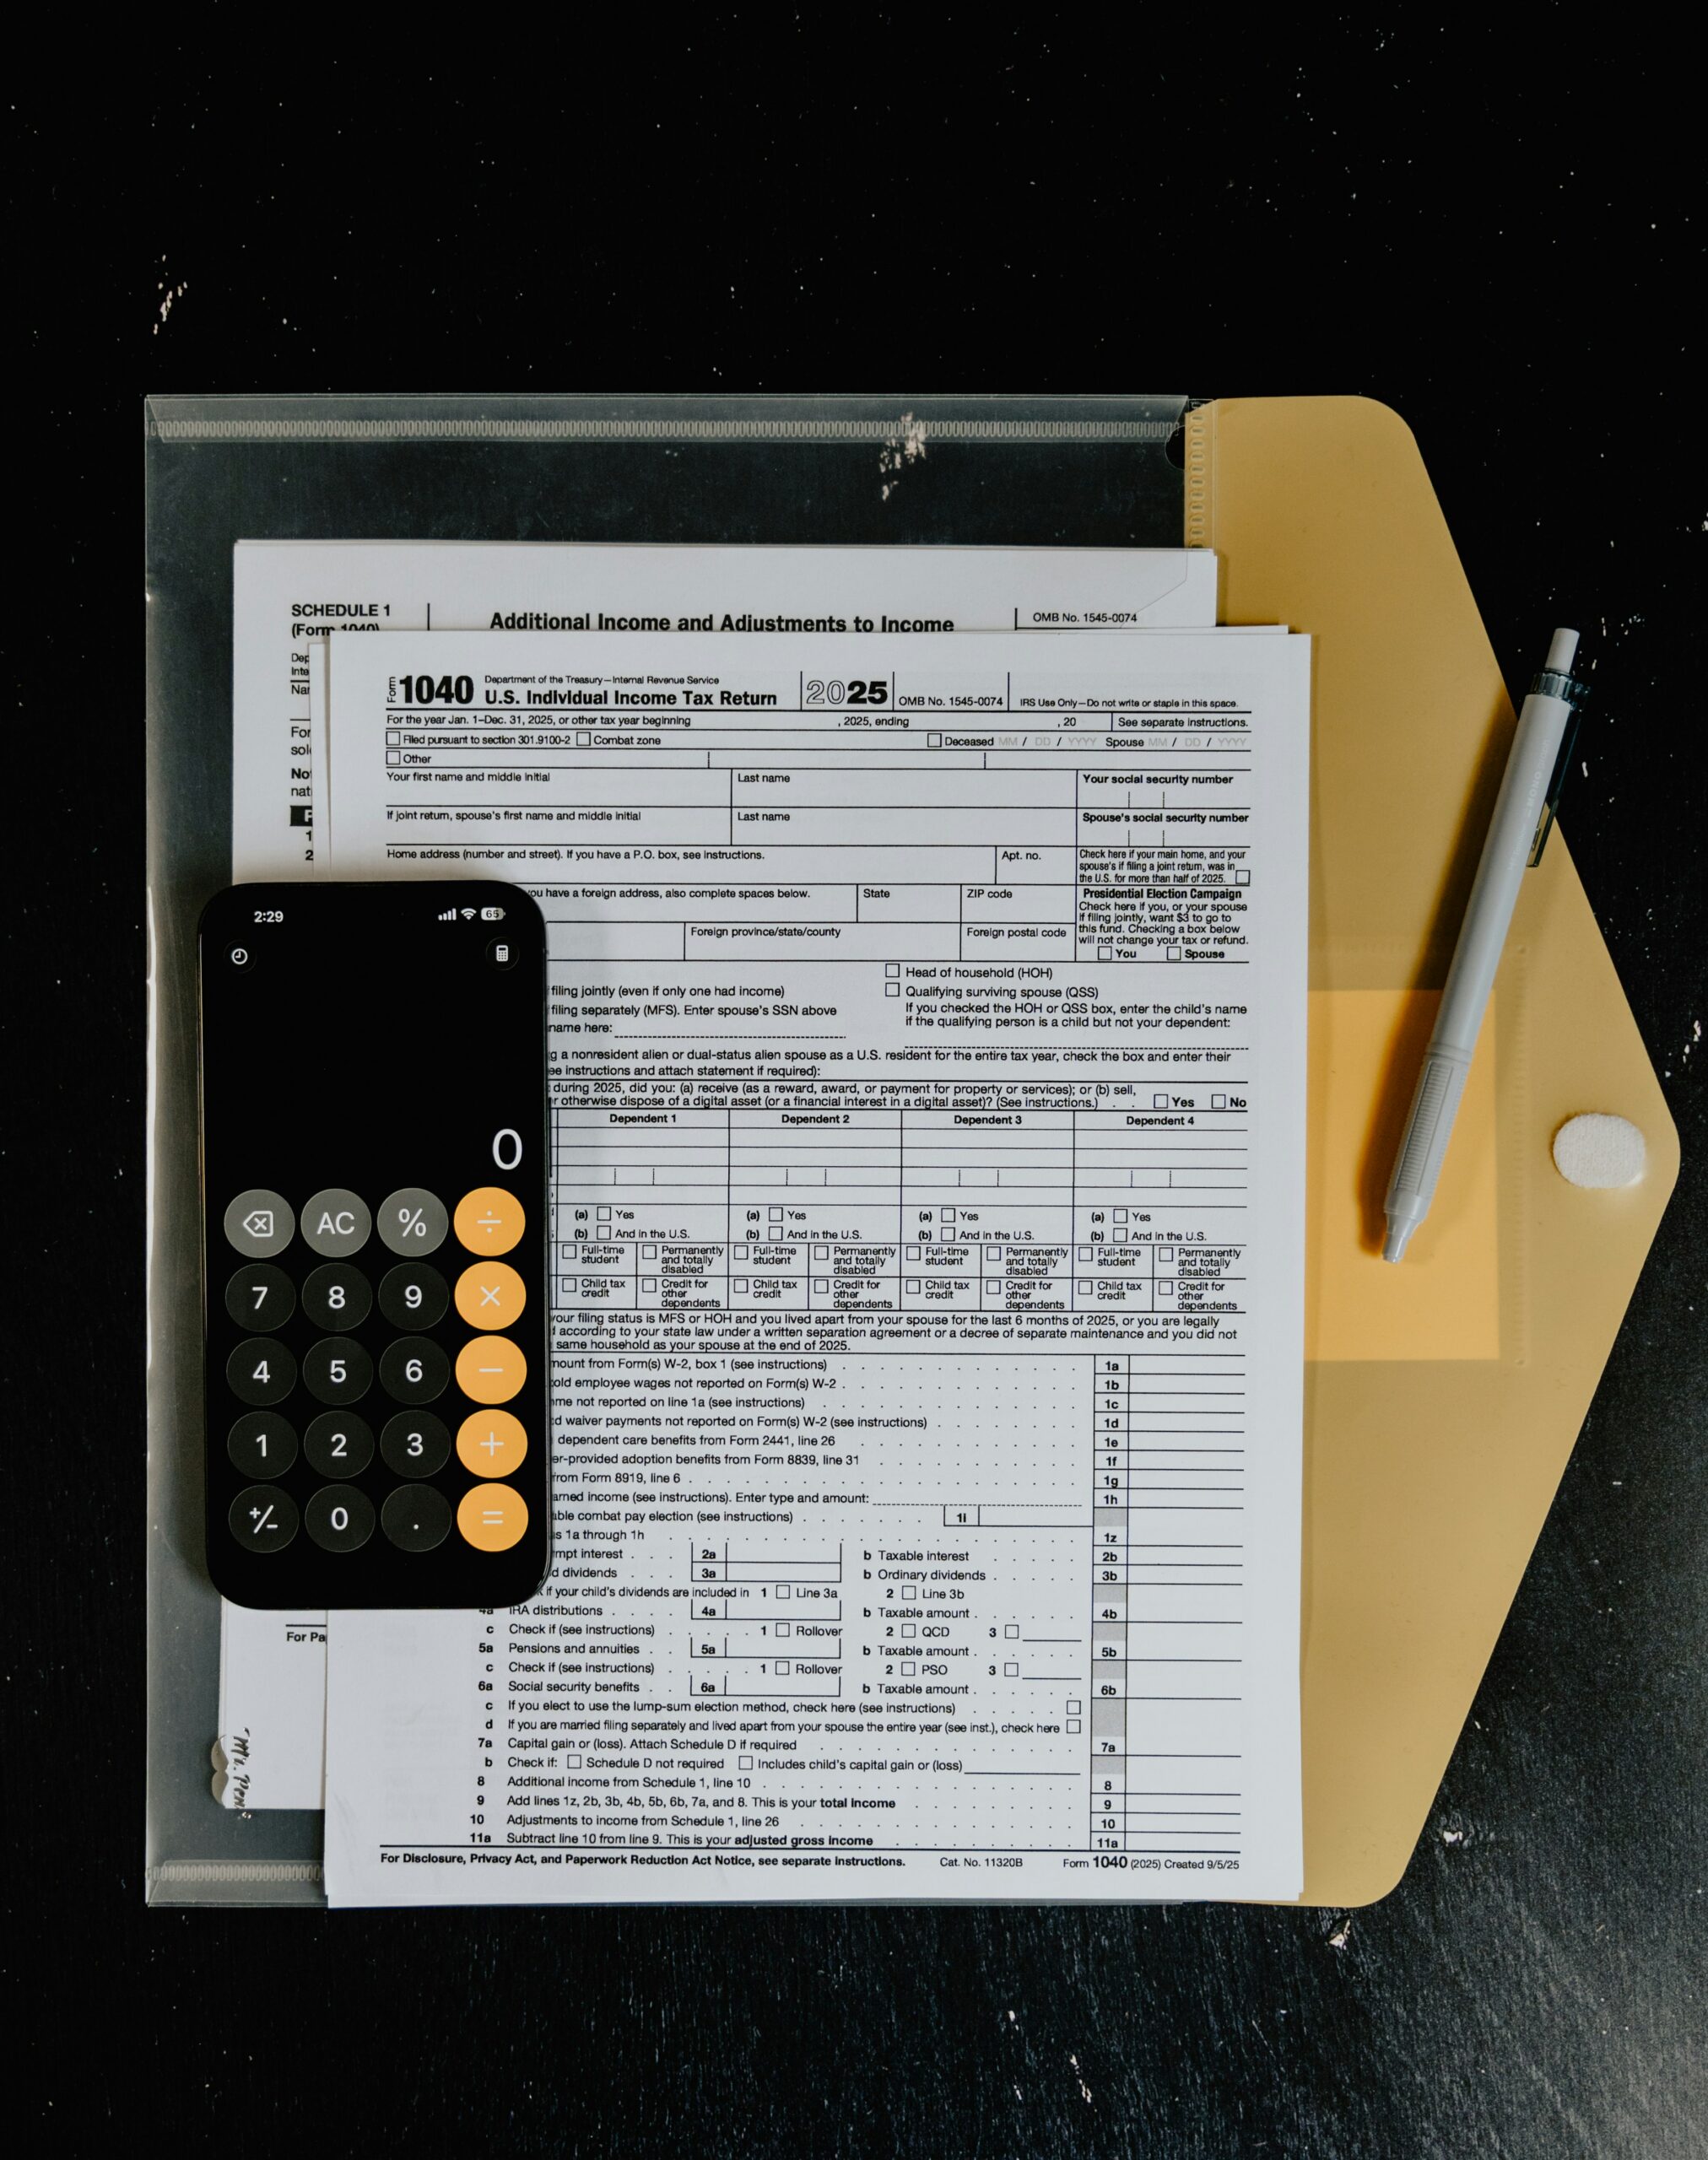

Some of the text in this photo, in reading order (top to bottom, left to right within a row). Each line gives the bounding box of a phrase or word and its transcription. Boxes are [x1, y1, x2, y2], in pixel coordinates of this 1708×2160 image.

[291, 603, 390, 618] SCHEDULE 1
[489, 612, 954, 632] Additional Income and Adjustments to Income
[1032, 612, 1138, 624] OMB No. 1545-0074
[484, 675, 536, 685] Department
[538, 675, 548, 684] of
[549, 675, 564, 684] the
[646, 676, 685, 684] Revenue
[686, 675, 720, 685] Service
[386, 676, 397, 703] Form
[399, 675, 474, 705] 1040
[806, 680, 889, 705] 2025
[485, 689, 777, 706] U.S. Individual Income Tax Return
[899, 695, 1003, 706] OMB No. 1545-0074
[1020, 698, 1036, 707] IRS
[1037, 698, 1056, 707] Use
[1101, 699, 1116, 708] not
[1118, 699, 1140, 708] write
[1153, 699, 1180, 709] staple
[1181, 699, 1190, 708] in
[1192, 699, 1208, 708] this
[1209, 700, 1239, 709] space.
[386, 715, 404, 725] For
[405, 715, 422, 725] the
[424, 716, 446, 726] year
[447, 715, 469, 725] Jan.
[509, 715, 526, 726] 31,
[527, 715, 556, 726] 2025,
[558, 716, 570, 725] or
[571, 715, 598, 725] other
[600, 716, 616, 725] tax
[618, 716, 640, 727] year
[642, 715, 691, 728] beginning
[1118, 716, 1248, 729] See separate instructions.
[944, 737, 995, 747] Deceased
[1105, 737, 1145, 749] Spouse
[738, 773, 791, 783] Last name
[1083, 774, 1235, 786] Your social security number
[1001, 850, 1041, 862] Apt. no.
[966, 888, 1013, 899] ZIP code
[1083, 888, 1242, 901] Presidential Election Campaign
[254, 910, 284, 923] 2:29
[485, 909, 500, 920] 65
[966, 926, 1067, 939] Foreign postal code
[905, 966, 1053, 981] Head of household (HOH)
[905, 986, 1099, 1000] Qualifying surviving spouse (QSS)
[1171, 1096, 1195, 1108] Yes
[1230, 1097, 1247, 1108] No
[609, 1113, 676, 1125] Dependent 1
[781, 1114, 850, 1126] Dependent 2
[954, 1115, 1022, 1126] Dependent 3
[1126, 1115, 1195, 1128] Dependent 4
[492, 1128, 522, 1170] 0
[316, 1212, 355, 1235] AC
[398, 1207, 427, 1237] %
[251, 1286, 268, 1310] 7
[328, 1285, 346, 1310] 8
[404, 1285, 423, 1309] 9
[252, 1360, 271, 1384] 4
[330, 1359, 347, 1383] 5
[405, 1358, 423, 1383] 6
[1105, 1360, 1120, 1372] 1a
[1105, 1380, 1120, 1390] 1b
[1105, 1398, 1119, 1410] 1c
[256, 1434, 267, 1457] 1
[331, 1434, 348, 1456] 2
[407, 1433, 424, 1456] 3
[1105, 1437, 1119, 1448] 1e
[331, 1507, 349, 1531] 0
[486, 1623, 655, 1638] c Check if (see instructions)
[478, 1642, 640, 1655] 5a Pensions and annuities
[508, 1680, 640, 1694] Social security benefits
[477, 1775, 751, 1790] 8 Additional income from Schedule 1, line 10
[381, 1853, 905, 1868] For Disclosure, Privacy Act, and Paperwork Reduction Act Notice, see separate instructions.
[939, 1856, 1024, 1867] Cat. No. 11320B
[1062, 1855, 1240, 1871] Form 1040 (2025) Created 9/5/25
